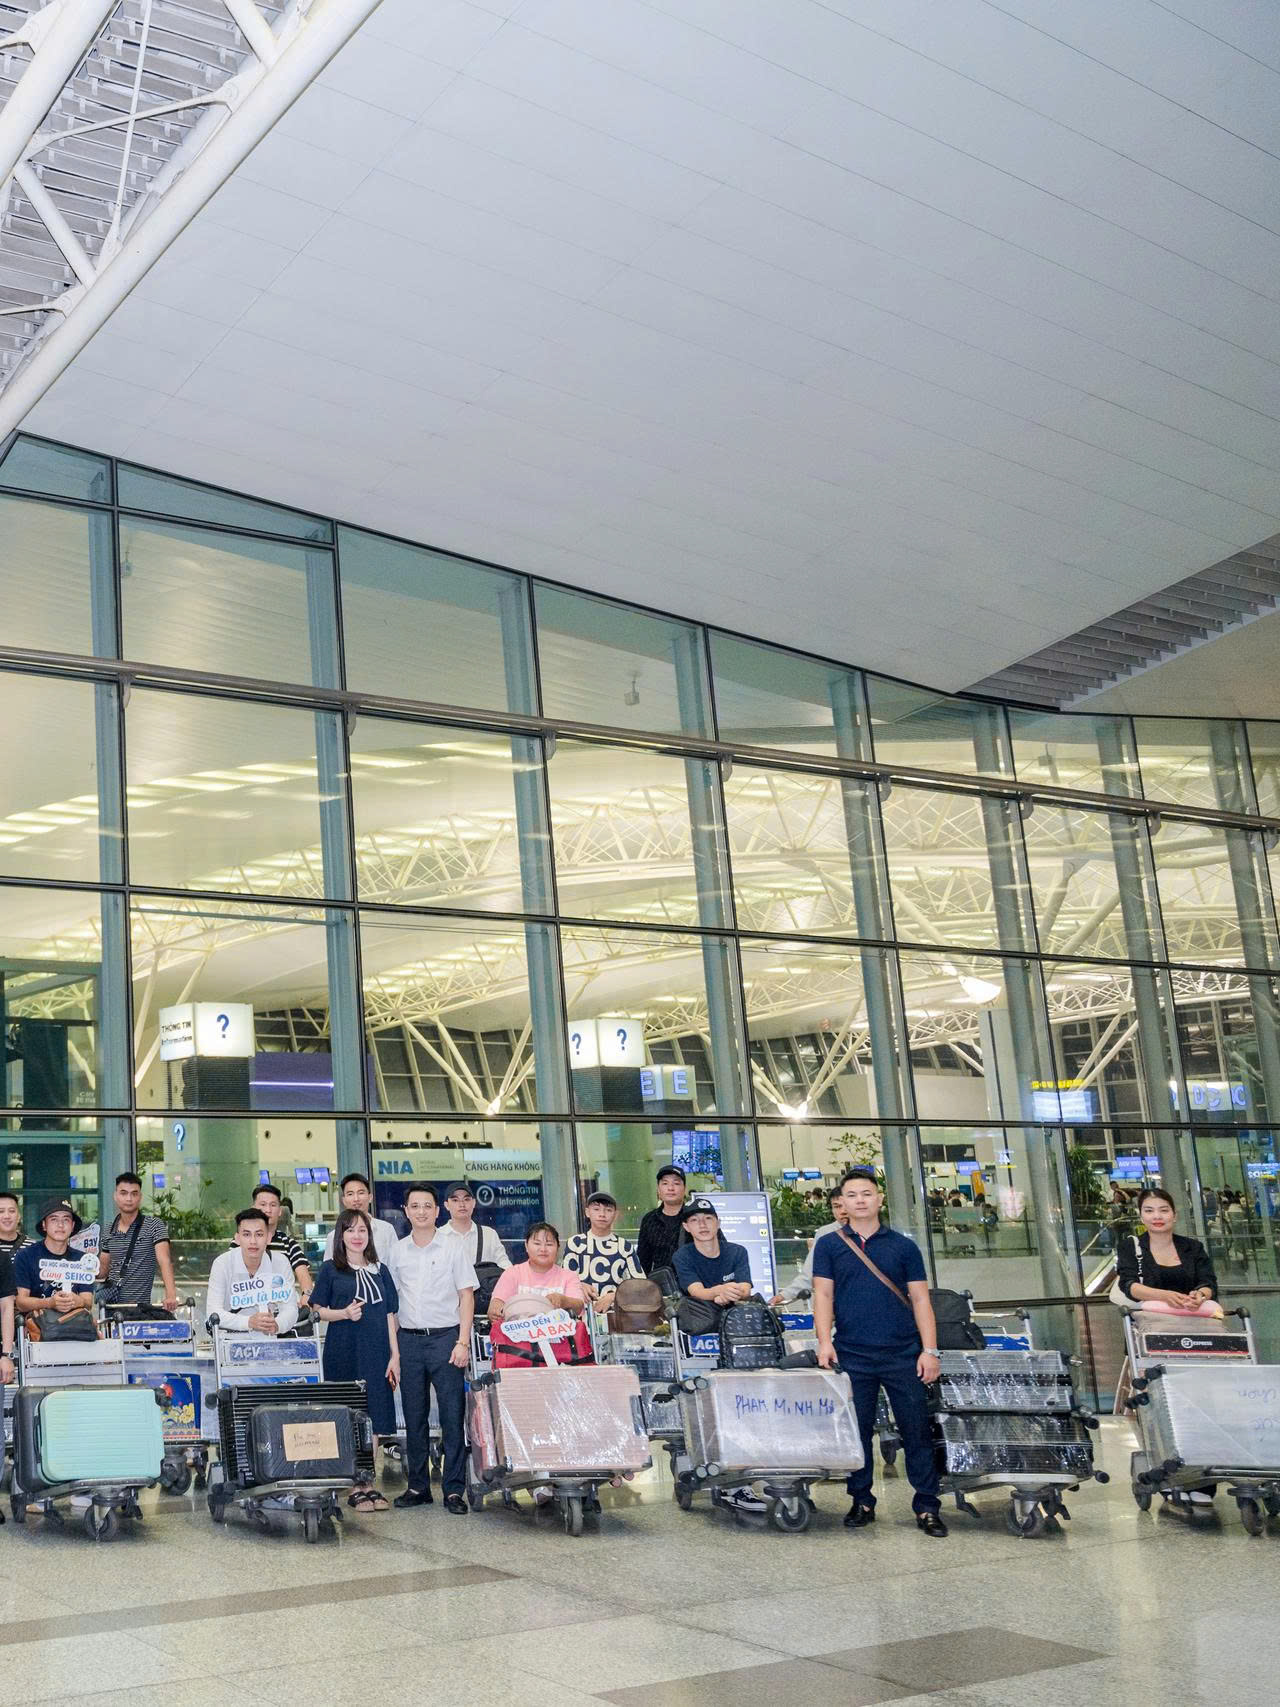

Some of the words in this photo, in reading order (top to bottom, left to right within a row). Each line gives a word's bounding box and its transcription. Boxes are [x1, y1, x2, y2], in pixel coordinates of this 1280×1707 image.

[673, 1071, 689, 1094] E
[378, 1160, 414, 1175] NIA
[498, 1184, 526, 1195] THÔNG
[499, 1197, 540, 1206] Information
[65, 1272, 93, 1282] SEIKO
[233, 1280, 264, 1293] SEIKO
[504, 1321, 531, 1332] SEIKO
[547, 1321, 574, 1336] BAY
